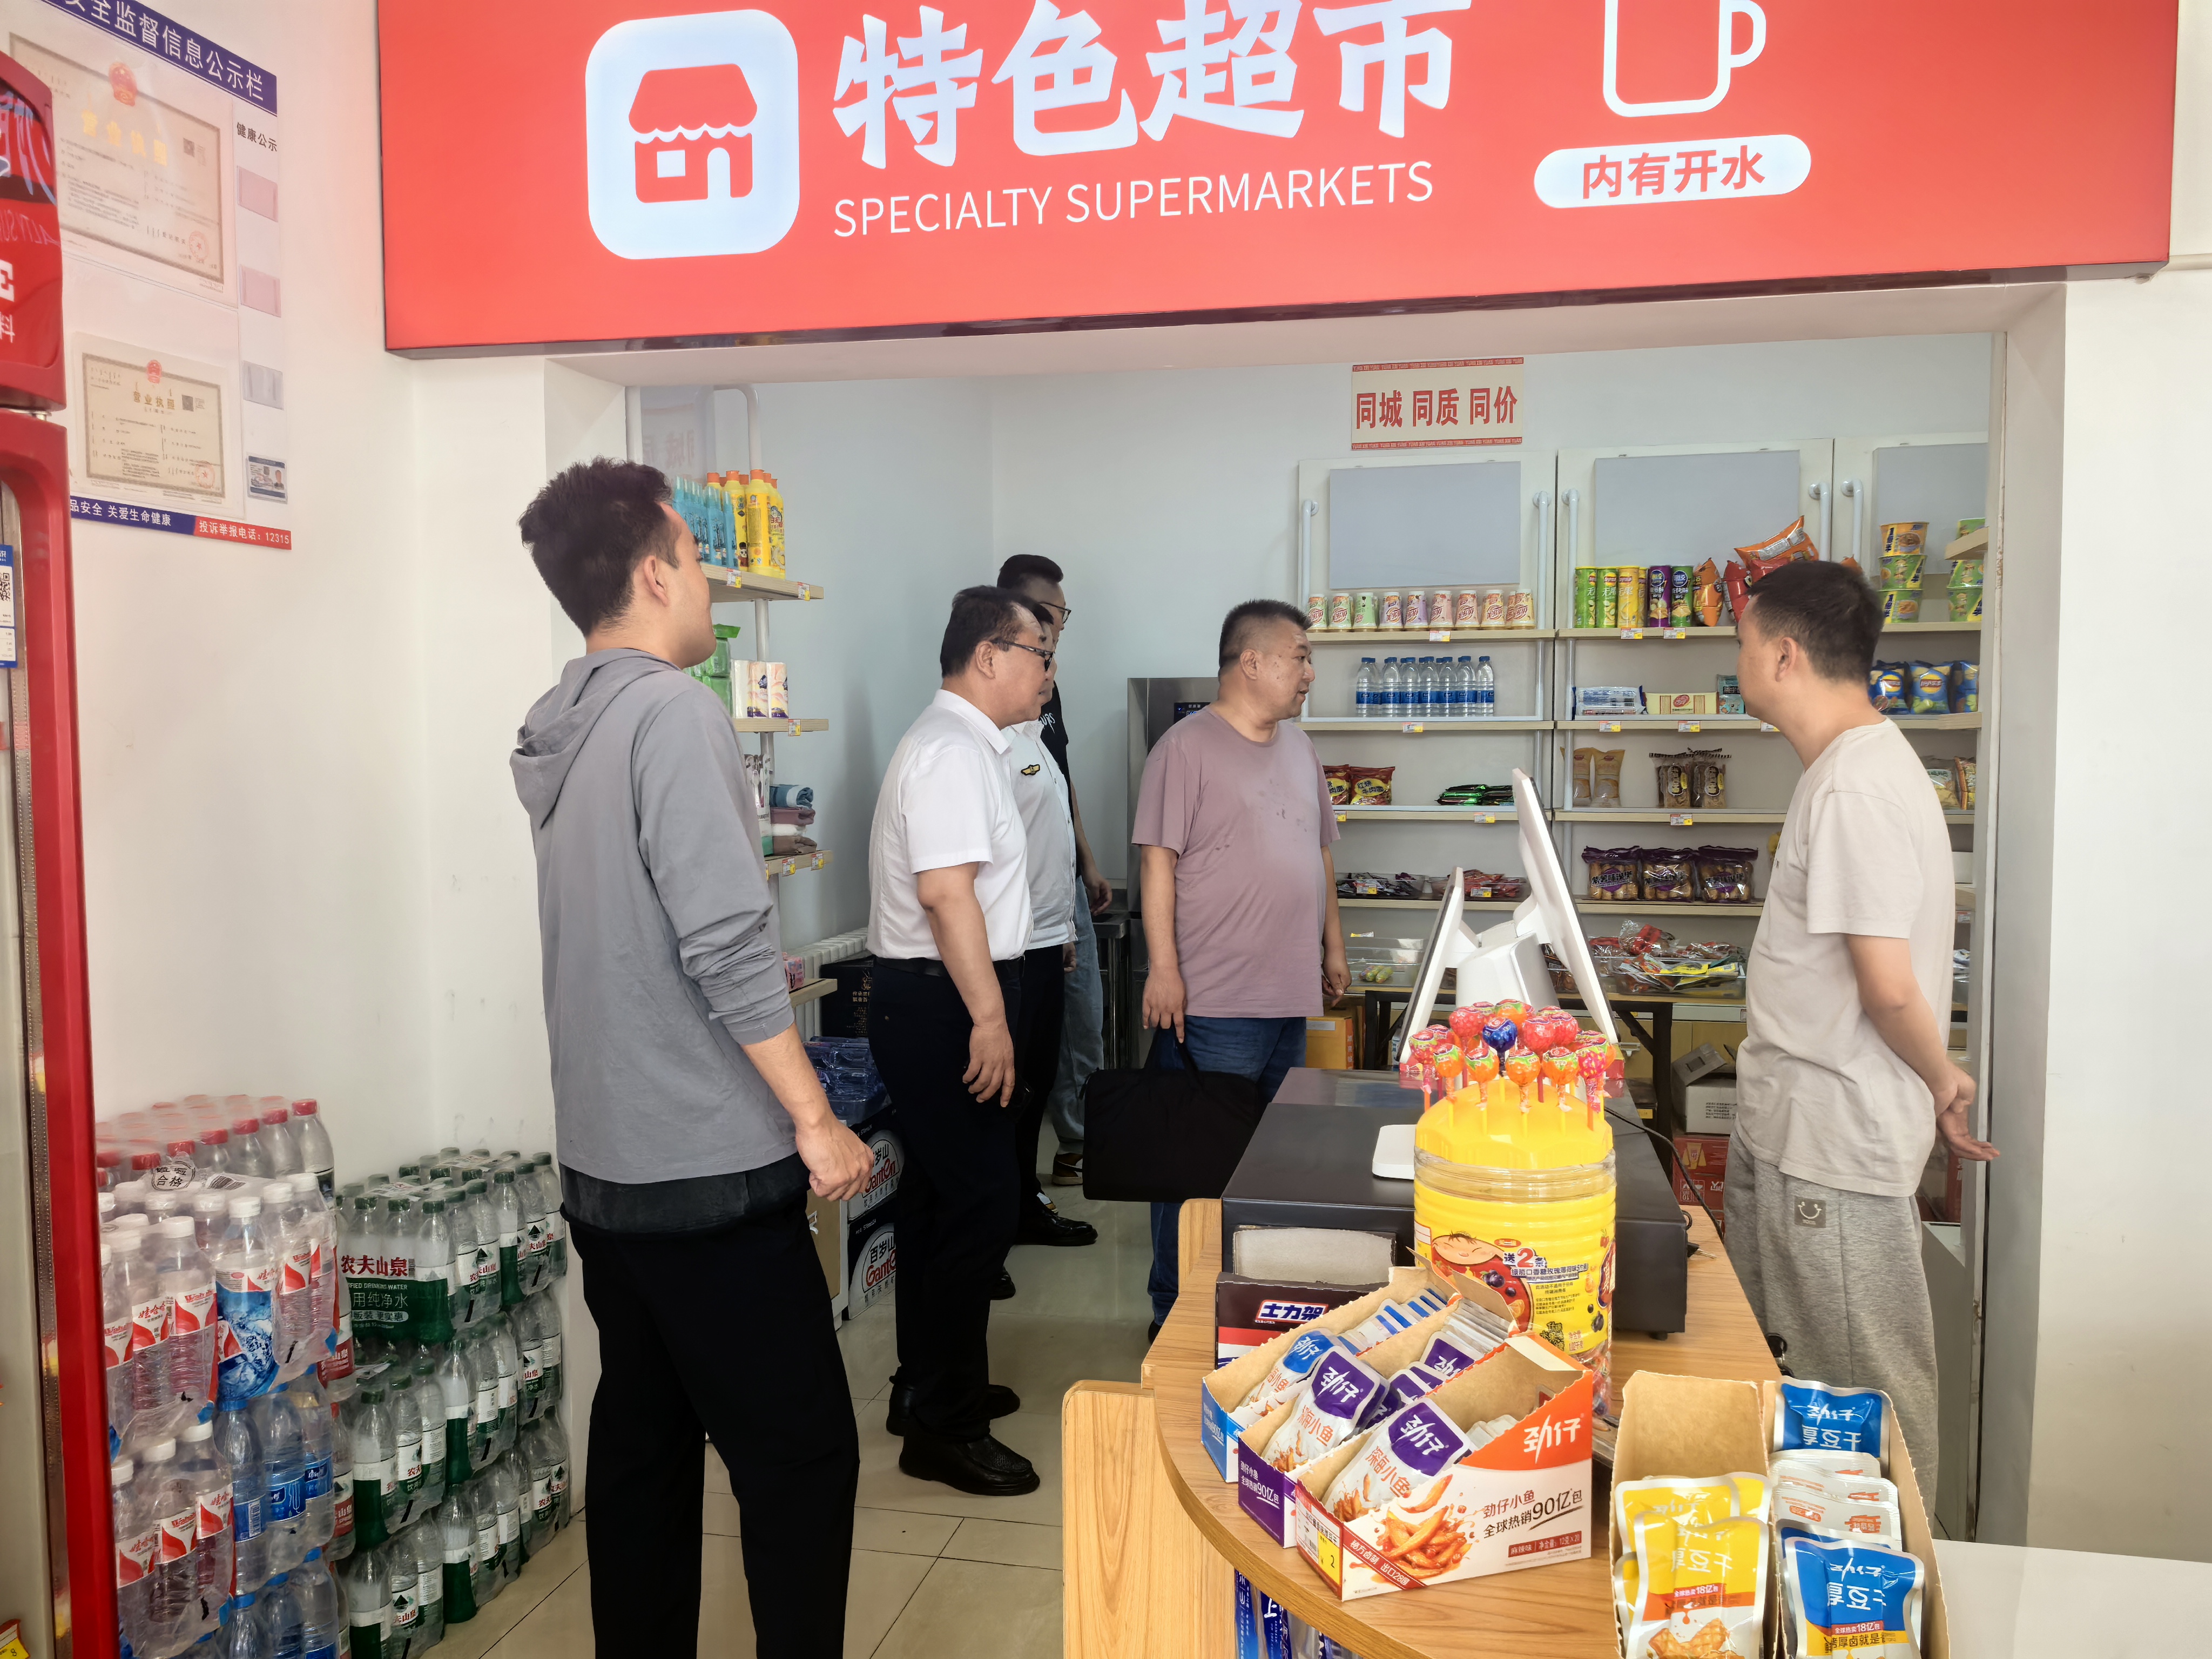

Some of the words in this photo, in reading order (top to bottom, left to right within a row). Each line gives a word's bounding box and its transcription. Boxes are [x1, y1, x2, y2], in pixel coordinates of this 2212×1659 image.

[832, 0, 1471, 169] 特色超市
[237, 122, 277, 152] 健康公示
[1583, 145, 1765, 199] 内有开水
[834, 186, 1052, 237] SPECIALTY
[1066, 161, 1433, 222] SUPERMARKETS
[1356, 390, 1402, 429] 同城
[1413, 388, 1459, 427] 同质
[1469, 386, 1518, 425] 同价
[108, 505, 171, 527] 关爱生命健康
[157, 1175, 184, 1187] 合格
[870, 1236, 895, 1264] 百岁山
[341, 1255, 408, 1277] 农夫山泉
[866, 1249, 896, 1287] Gante
[138, 1301, 166, 1319] 娃哈哈
[353, 1292, 408, 1309] 用纯净水
[1260, 1304, 1324, 1321] 士力架
[1317, 1366, 1360, 1403] 劲仔
[1807, 1404, 1853, 1426] 劲仔
[1391, 1414, 1445, 1455] 劲仔
[1524, 1414, 1581, 1464] 劲仔
[1240, 1461, 1259, 1481] 劲仔小鱼
[1365, 1446, 1411, 1498] 深海小鱼
[1483, 1489, 1535, 1519] 劲仔小鱼
[1483, 1488, 1582, 1539] 全球热销90亿包
[1331, 1555, 1336, 1569] 2
[1350, 1539, 1380, 1565] 秘方卤制
[1380, 1563, 1411, 1586] 出口28国
[1829, 1557, 1882, 1582] 劲仔
